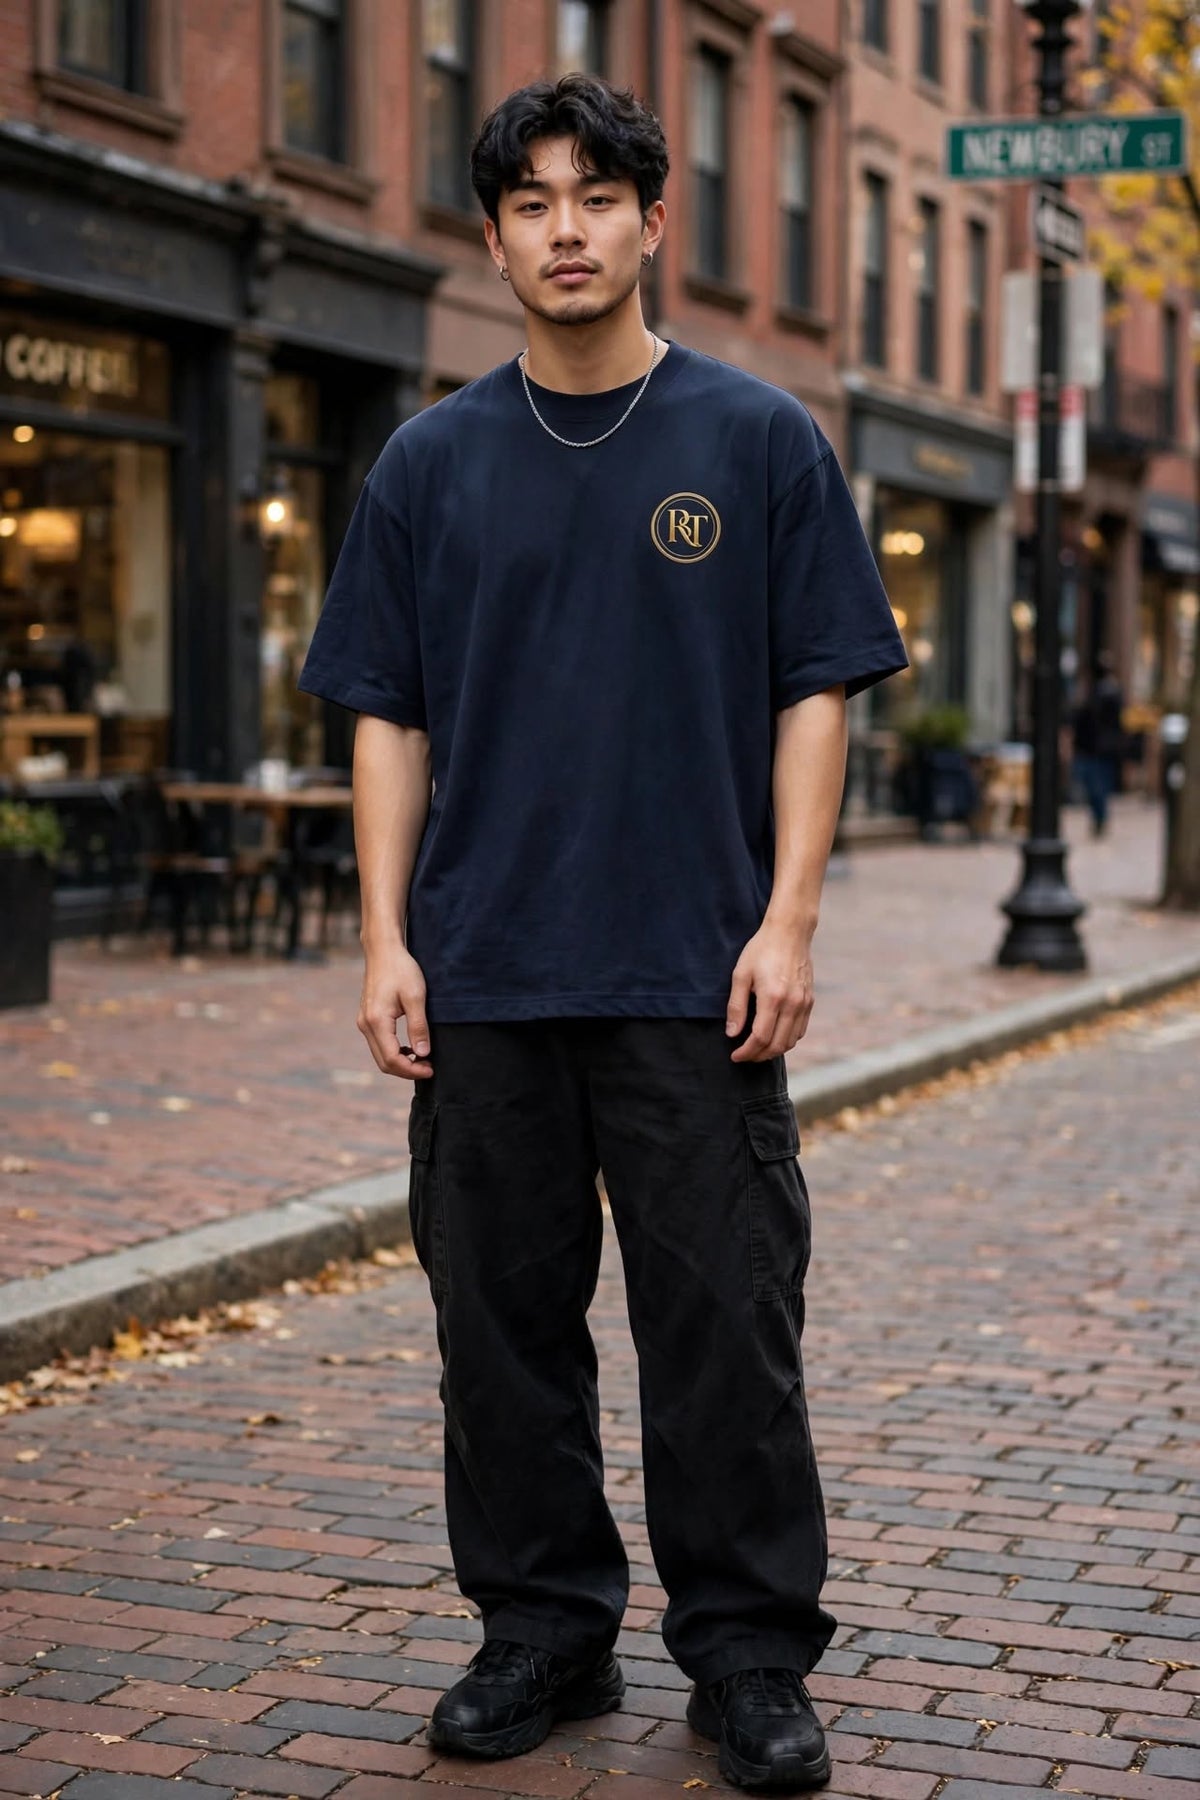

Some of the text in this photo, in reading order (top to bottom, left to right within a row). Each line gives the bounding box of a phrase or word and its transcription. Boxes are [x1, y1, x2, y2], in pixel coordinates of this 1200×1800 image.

[962, 124, 1174, 171] NEWBURY ST
[667, 508, 708, 548] RT
